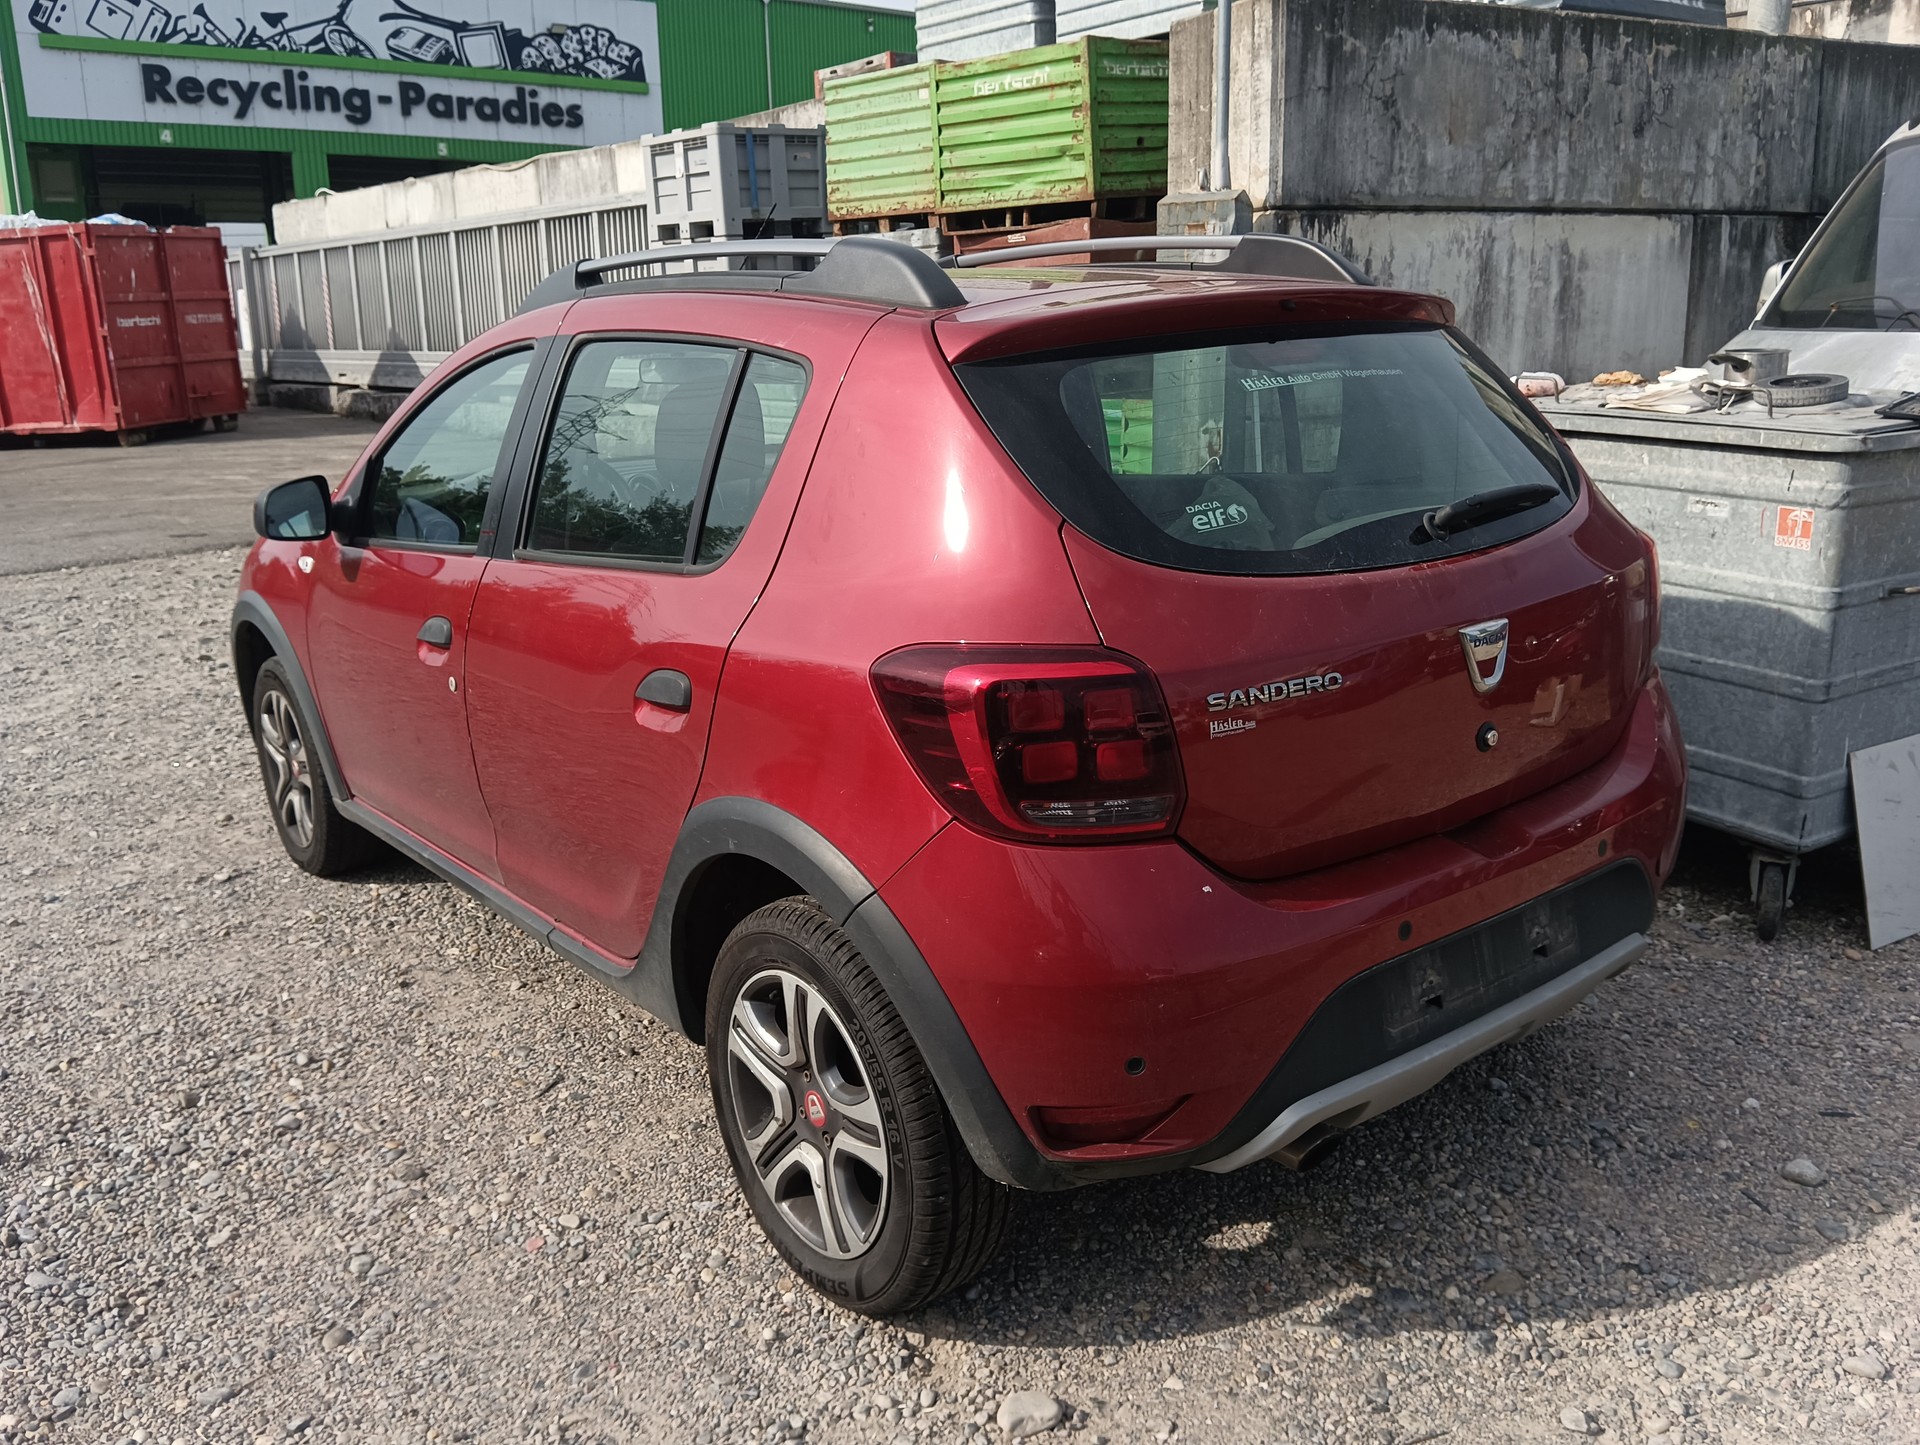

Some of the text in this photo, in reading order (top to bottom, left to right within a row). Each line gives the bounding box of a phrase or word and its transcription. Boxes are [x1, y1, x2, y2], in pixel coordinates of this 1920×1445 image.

[974, 66, 1050, 97] bertschi
[141, 63, 584, 129] Recycling-Paradies
[160, 129, 173, 144] 4
[437, 142, 448, 156] 5
[1287, 374, 1311, 384] Auto
[1311, 371, 1343, 381] GmbH
[1342, 368, 1403, 379] Wagenhausen
[1185, 501, 1222, 514] DACIA
[1192, 508, 1226, 530] elf
[1775, 537, 1810, 551] SWISS
[1206, 672, 1343, 712] SANDERO
[849, 1018, 905, 1170] 205/55 R 16 V
